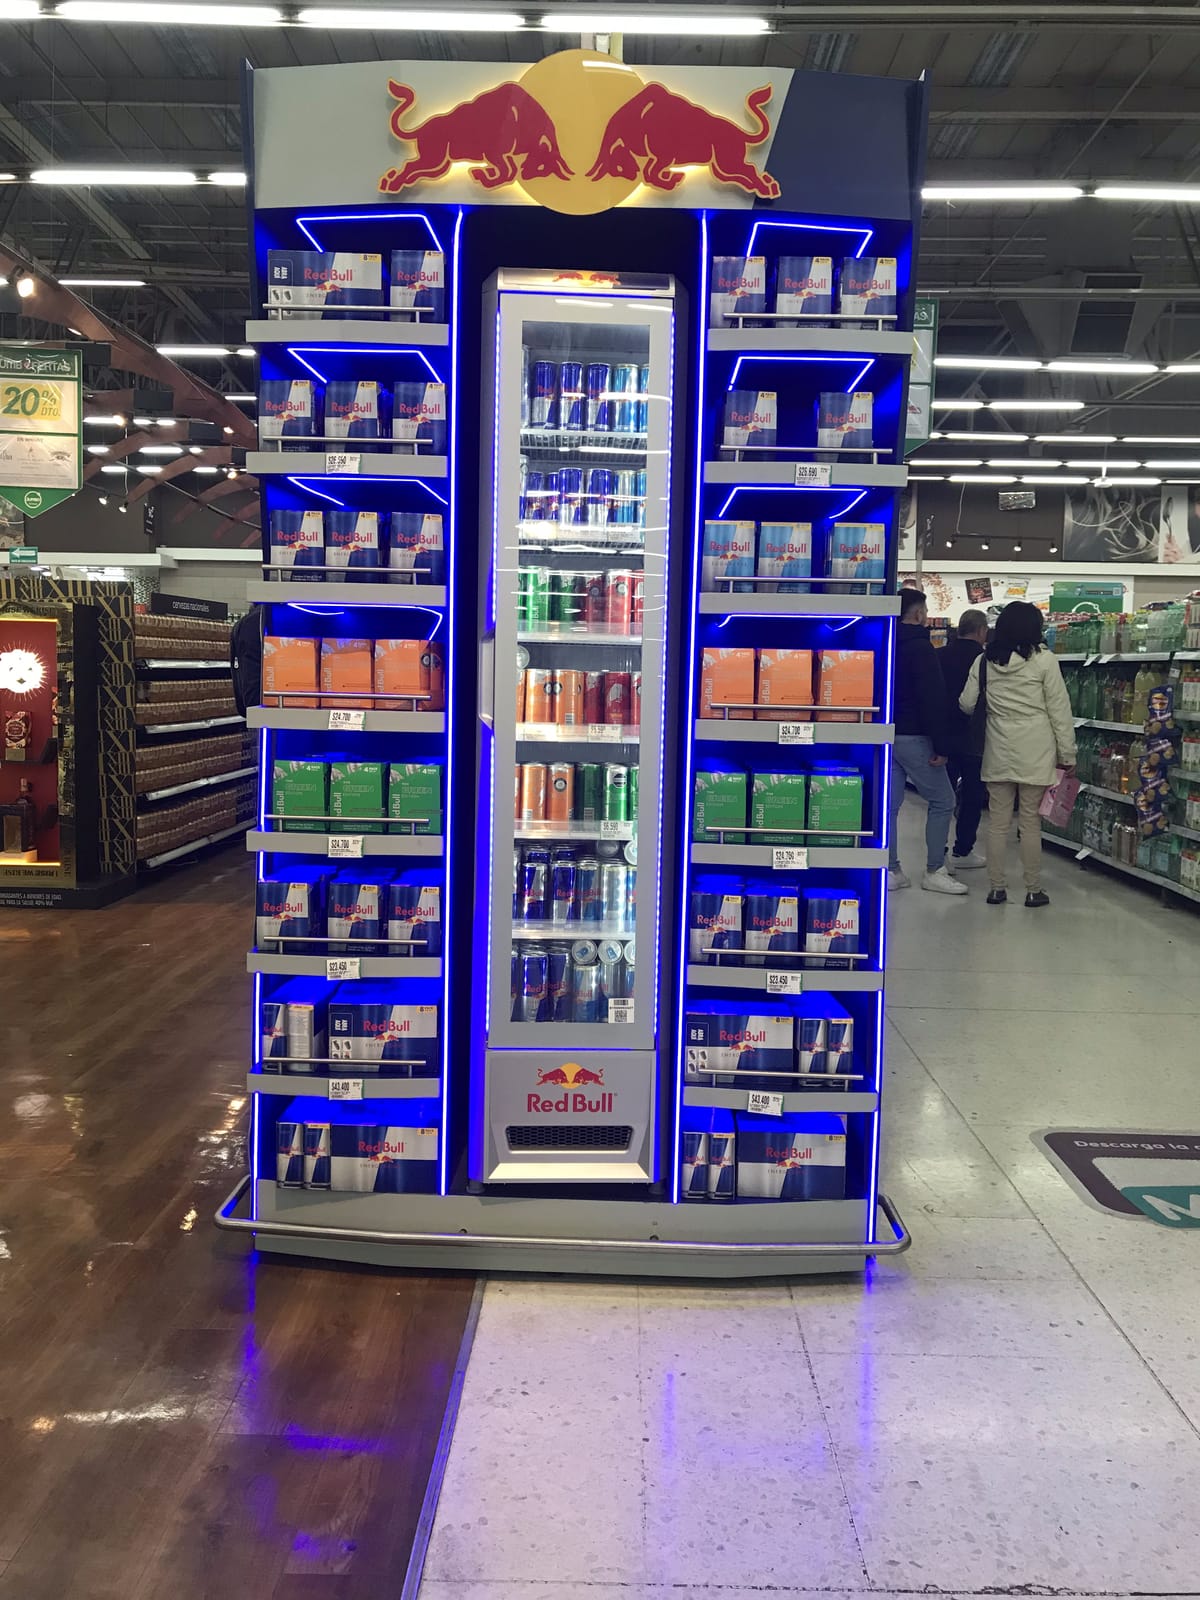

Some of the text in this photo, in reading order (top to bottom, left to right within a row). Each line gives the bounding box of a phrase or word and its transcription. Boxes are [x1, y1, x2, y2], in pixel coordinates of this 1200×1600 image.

[303, 268, 353, 282] Red Bull
[397, 272, 439, 282] Red Bull
[718, 277, 760, 288] Red Bull
[784, 278, 826, 288] Red Bull
[849, 280, 891, 289] Red Bull
[265, 401, 305, 411] Red Bull
[332, 402, 372, 413] Red Bull
[400, 403, 440, 414] Red Bull
[731, 412, 771, 422] Red Bull
[825, 414, 867, 423] Red Bull
[277, 531, 318, 542] Red Bull
[332, 532, 372, 543] Red Bull
[397, 533, 438, 545] Red Bull
[710, 541, 750, 551] Red Bull
[766, 543, 807, 553] Red Bull
[840, 544, 880, 554] Red Bull
[276, 791, 284, 806] Bull
[333, 792, 341, 807] Bull
[392, 794, 400, 808] Bull
[756, 804, 764, 819] Bull
[812, 805, 820, 821] Bull
[263, 902, 303, 912] Red Bull
[334, 904, 373, 914] Red Bull
[395, 906, 435, 916] Red Bull
[697, 915, 736, 925] Red Bull
[753, 917, 792, 926] Red Bull
[813, 919, 853, 929] Red Bull
[769, 975, 788, 985] $23.450
[363, 1020, 410, 1033] Red Bull
[719, 1030, 766, 1042] Red Bull
[331, 1082, 349, 1091] $43.400
[527, 1093, 613, 1112] Red Bull
[751, 1095, 770, 1105] $43.400
[358, 1141, 404, 1153] Red Bull
[1073, 1140, 1165, 1150] Descarga
[766, 1147, 812, 1159] Red Bull
